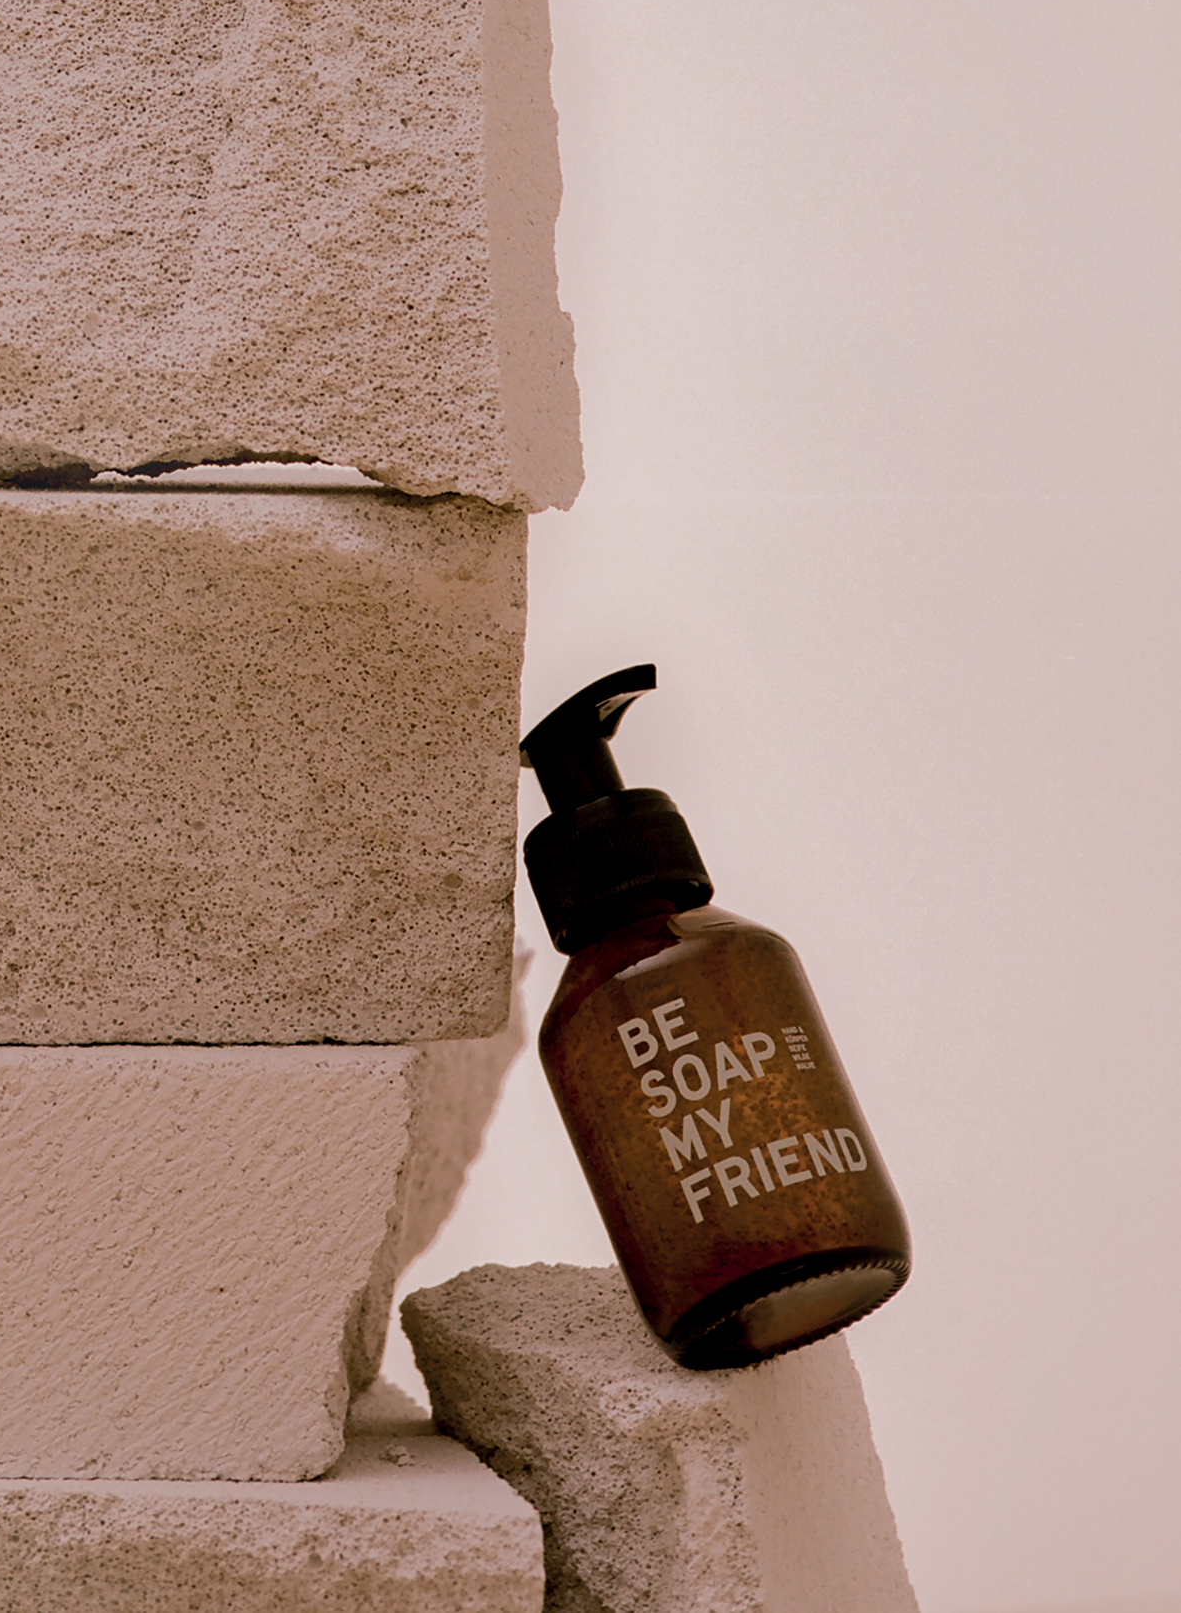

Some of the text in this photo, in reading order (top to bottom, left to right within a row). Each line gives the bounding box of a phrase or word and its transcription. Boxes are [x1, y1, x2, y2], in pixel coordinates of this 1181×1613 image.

[617, 997, 699, 1069] BE
[640, 1031, 776, 1118] SOAP
[659, 1098, 734, 1172] MY
[680, 1128, 868, 1224] FRIEND
